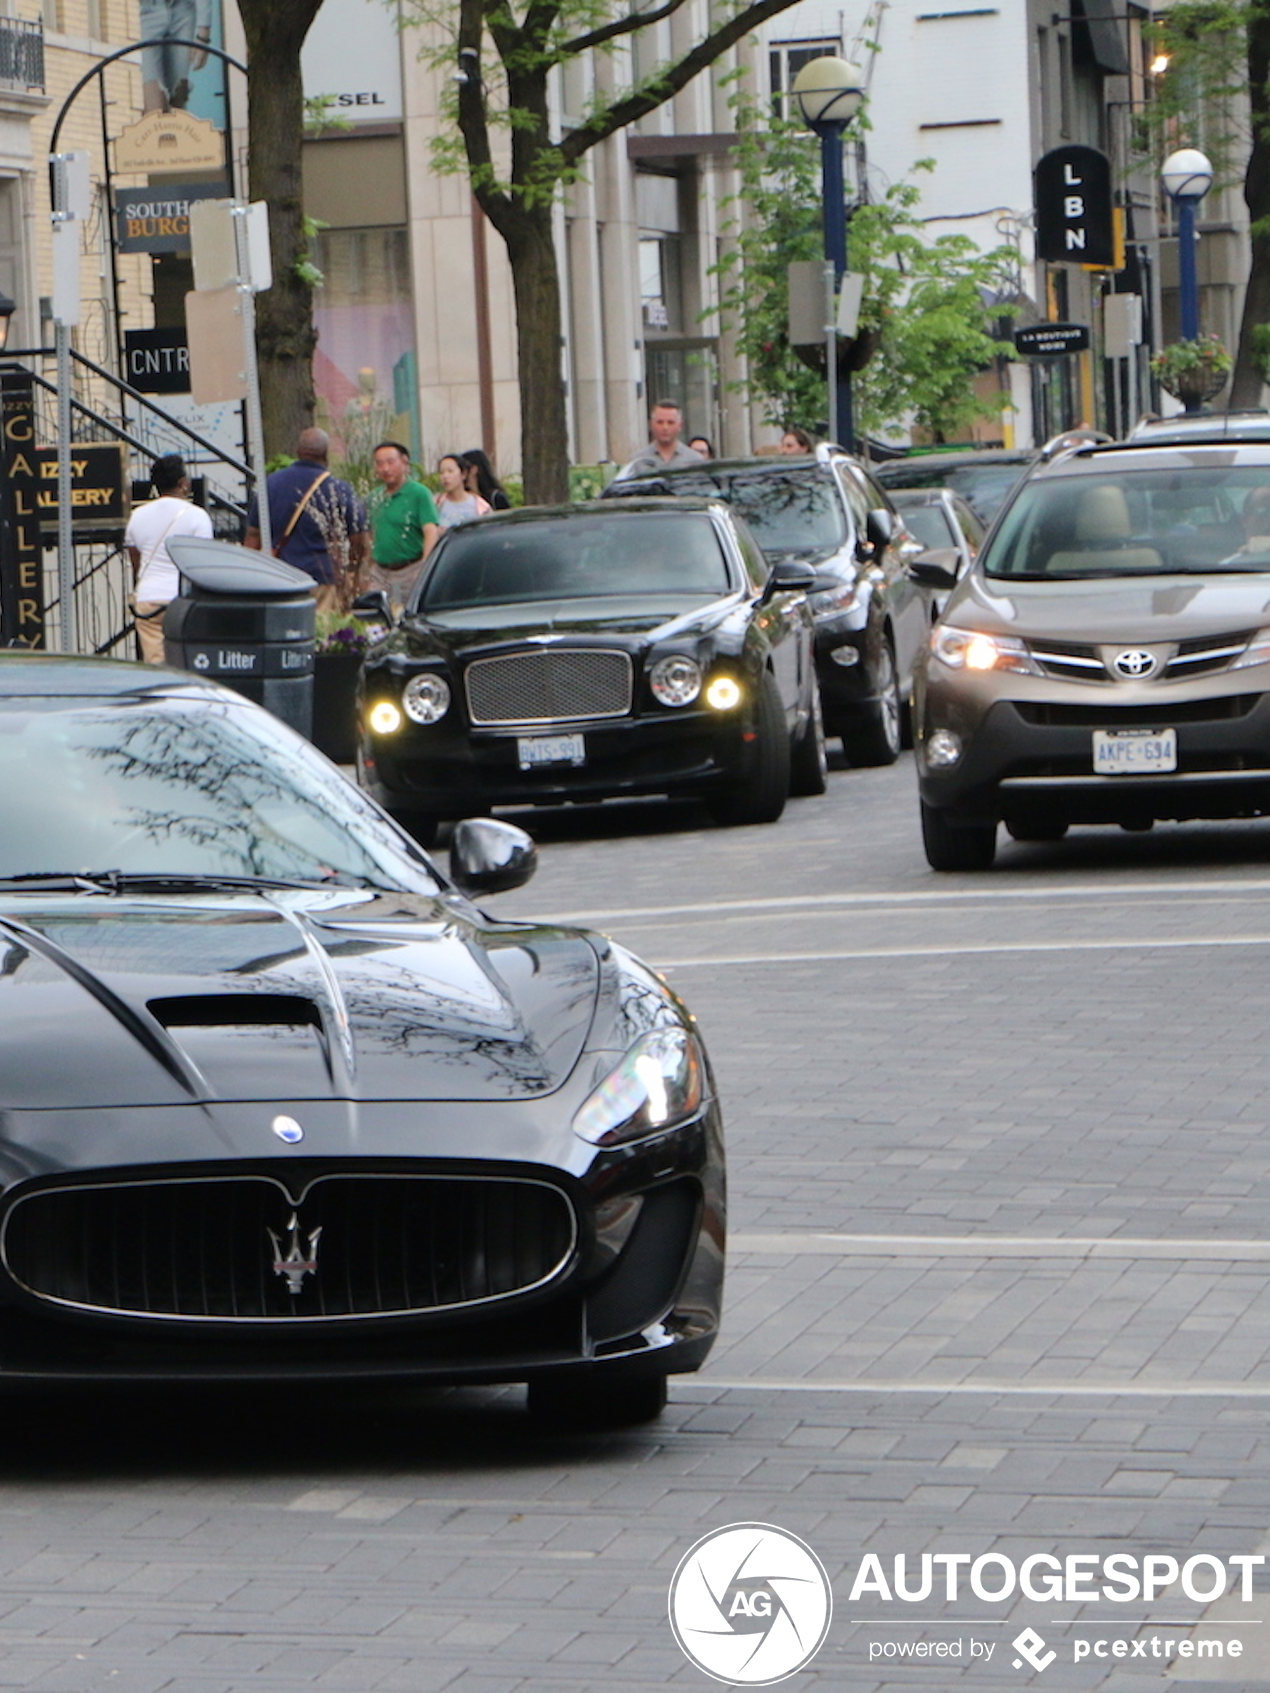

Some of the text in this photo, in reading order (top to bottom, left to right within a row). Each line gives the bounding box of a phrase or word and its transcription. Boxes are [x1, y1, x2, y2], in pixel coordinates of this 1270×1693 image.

[126, 201, 189, 219] SOUTH
[1063, 163, 1086, 250] LBN
[127, 217, 190, 237] BURG
[131, 347, 190, 375] CNTR
[40, 460, 89, 479] IZY
[5, 415, 42, 649] GALLERY
[219, 651, 257, 669] Litter
